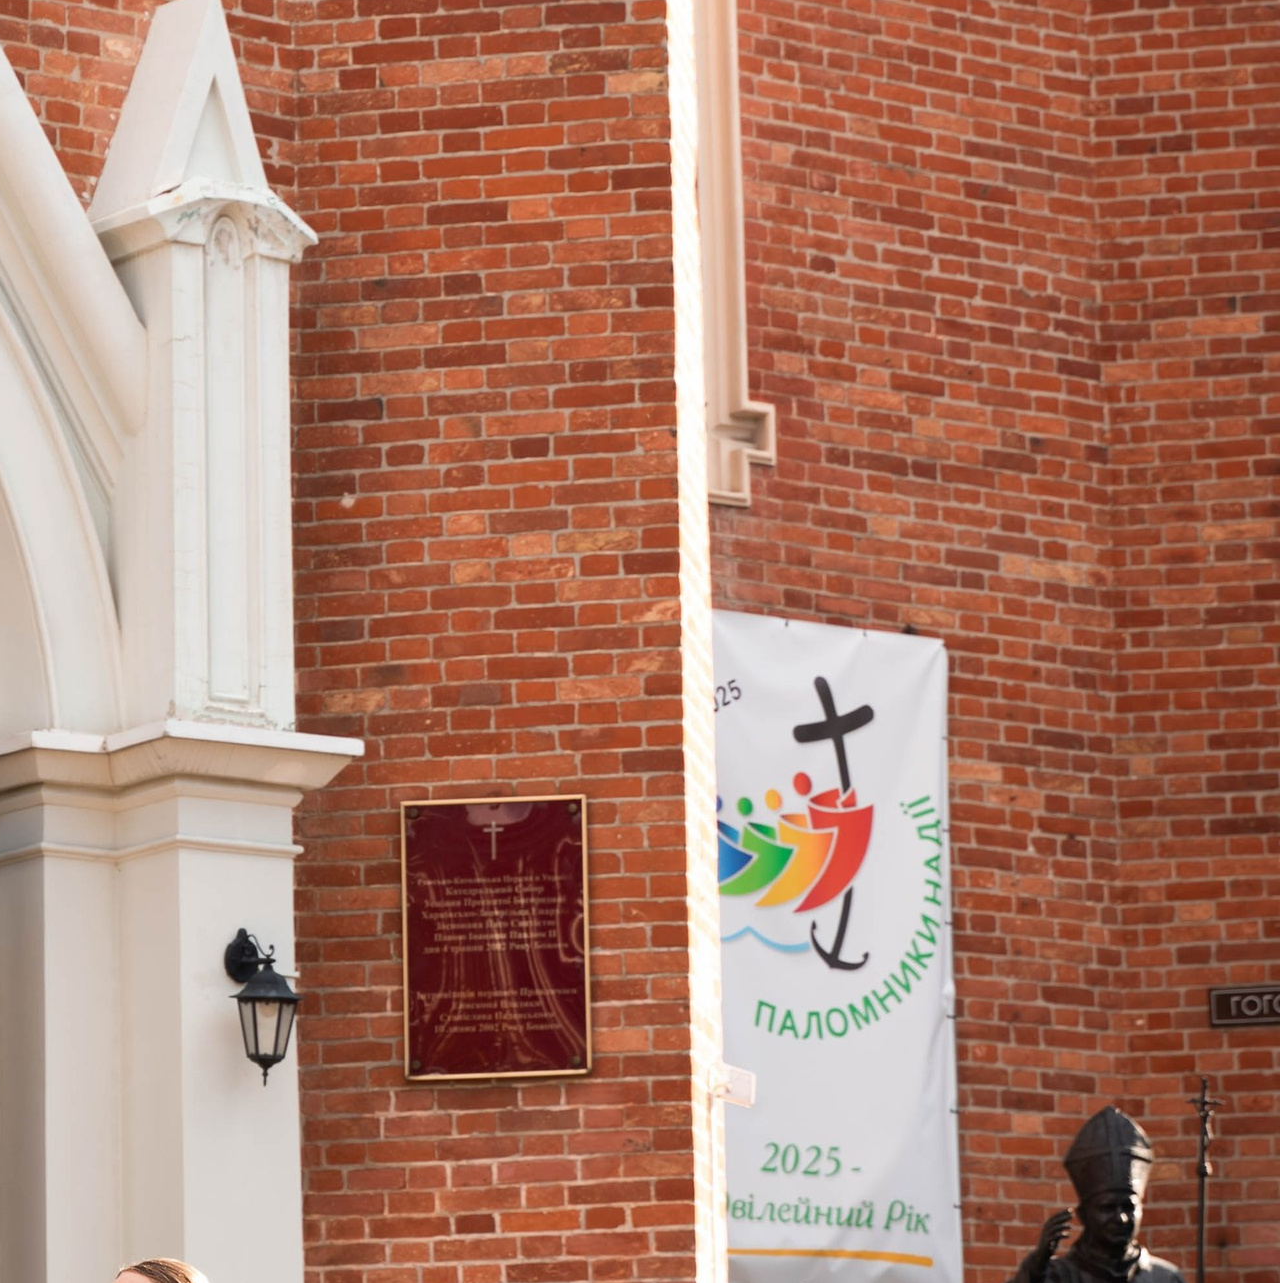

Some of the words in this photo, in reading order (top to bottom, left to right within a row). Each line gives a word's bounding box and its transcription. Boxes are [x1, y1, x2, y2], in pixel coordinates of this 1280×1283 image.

[713, 678, 742, 713] 25
[754, 913, 941, 1040] ПАЛОМНИКИ
[899, 795, 943, 907] НАДІЇ
[760, 1142, 841, 1177] 2025
[883, 1199, 930, 1234] Рік
